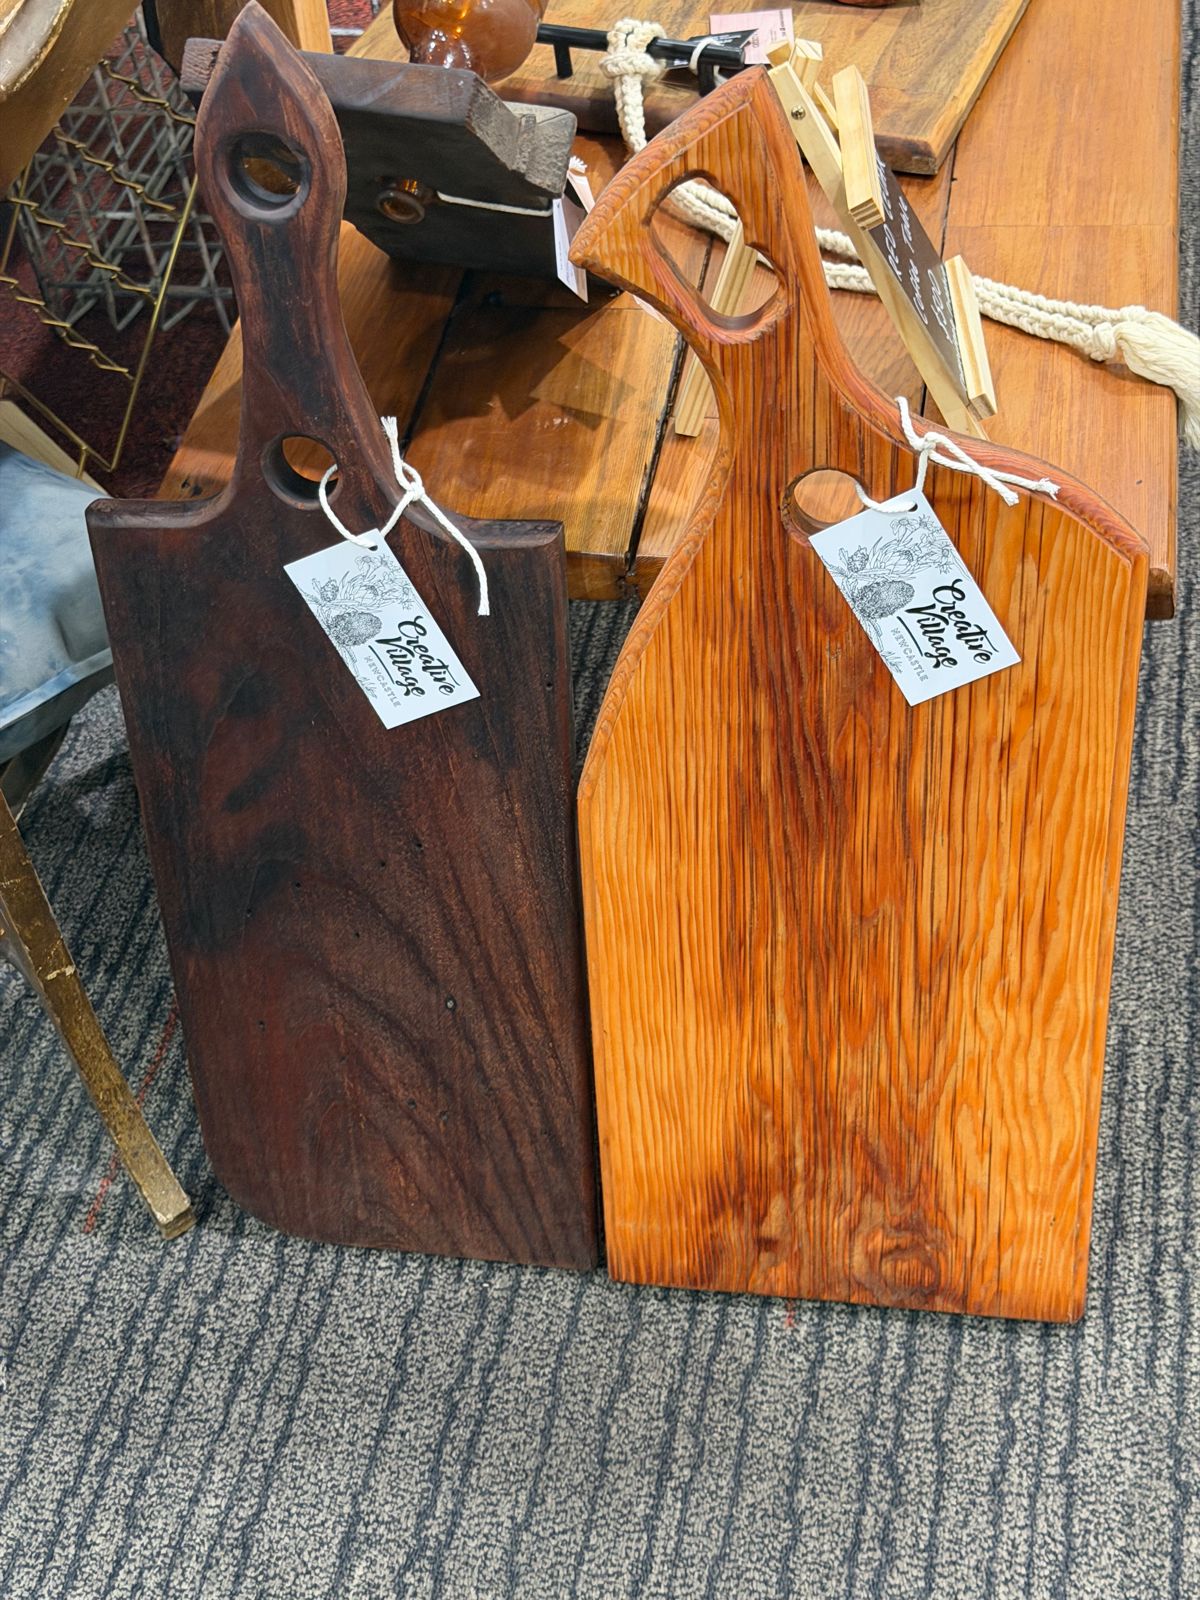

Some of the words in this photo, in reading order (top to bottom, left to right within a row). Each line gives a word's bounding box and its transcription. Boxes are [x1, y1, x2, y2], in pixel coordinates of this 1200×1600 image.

[883, 223, 902, 282] RED
[904, 603, 958, 669] Village
[932, 578, 999, 665] Creative
[363, 655, 402, 708] NEWCASTLE
[375, 636, 426, 697] Village
[397, 614, 460, 696] Creative
[890, 627, 929, 682] NEWCASTLE
